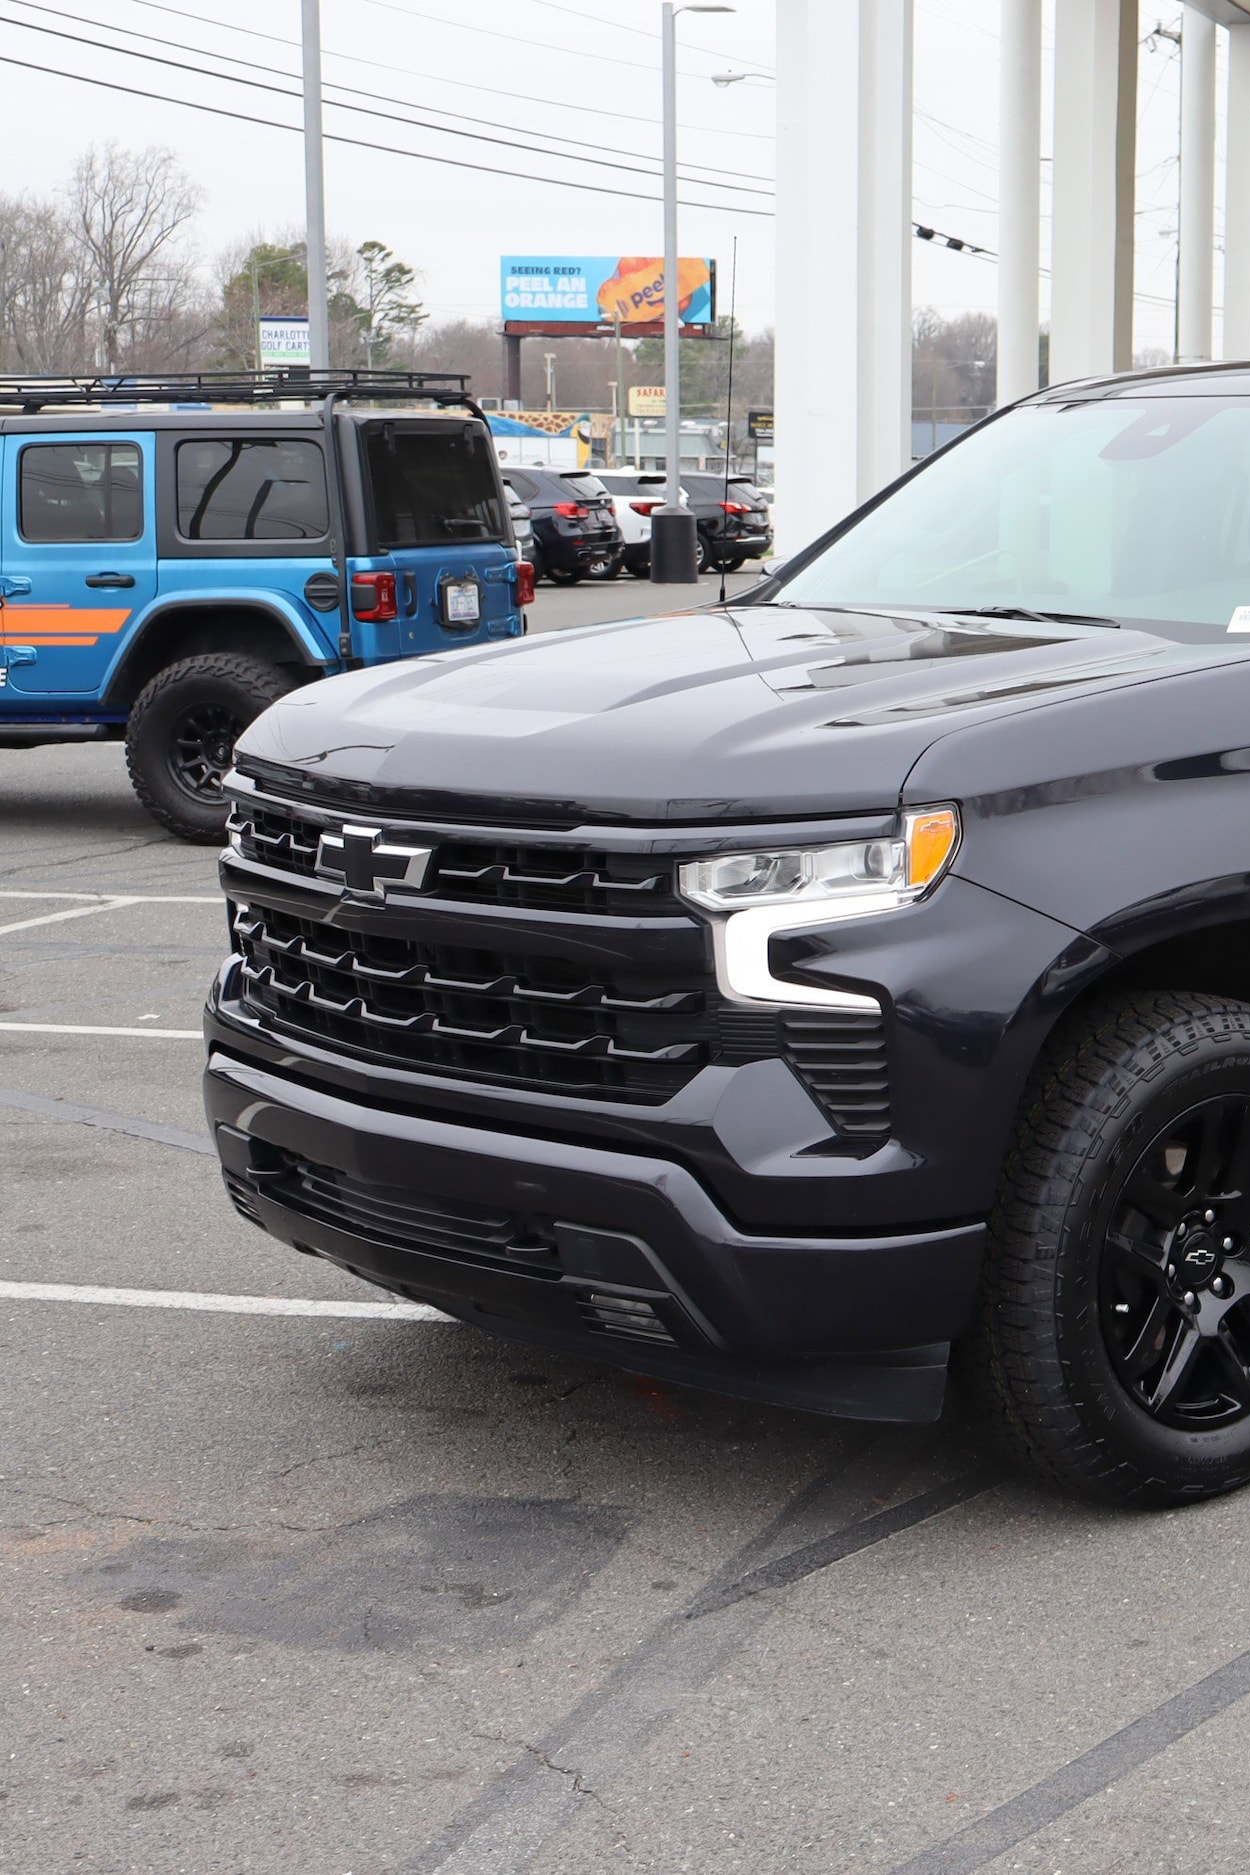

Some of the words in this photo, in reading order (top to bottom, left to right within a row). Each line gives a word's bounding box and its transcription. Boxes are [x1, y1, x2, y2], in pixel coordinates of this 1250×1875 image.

[511, 266, 551, 275] SEEING
[553, 266, 581, 275] RED?
[506, 276, 553, 292] PEEL
[556, 277, 586, 292] AN
[505, 292, 588, 308] ORANGE
[261, 341, 281, 351] GOLF
[637, 388, 666, 397] SAFAR
